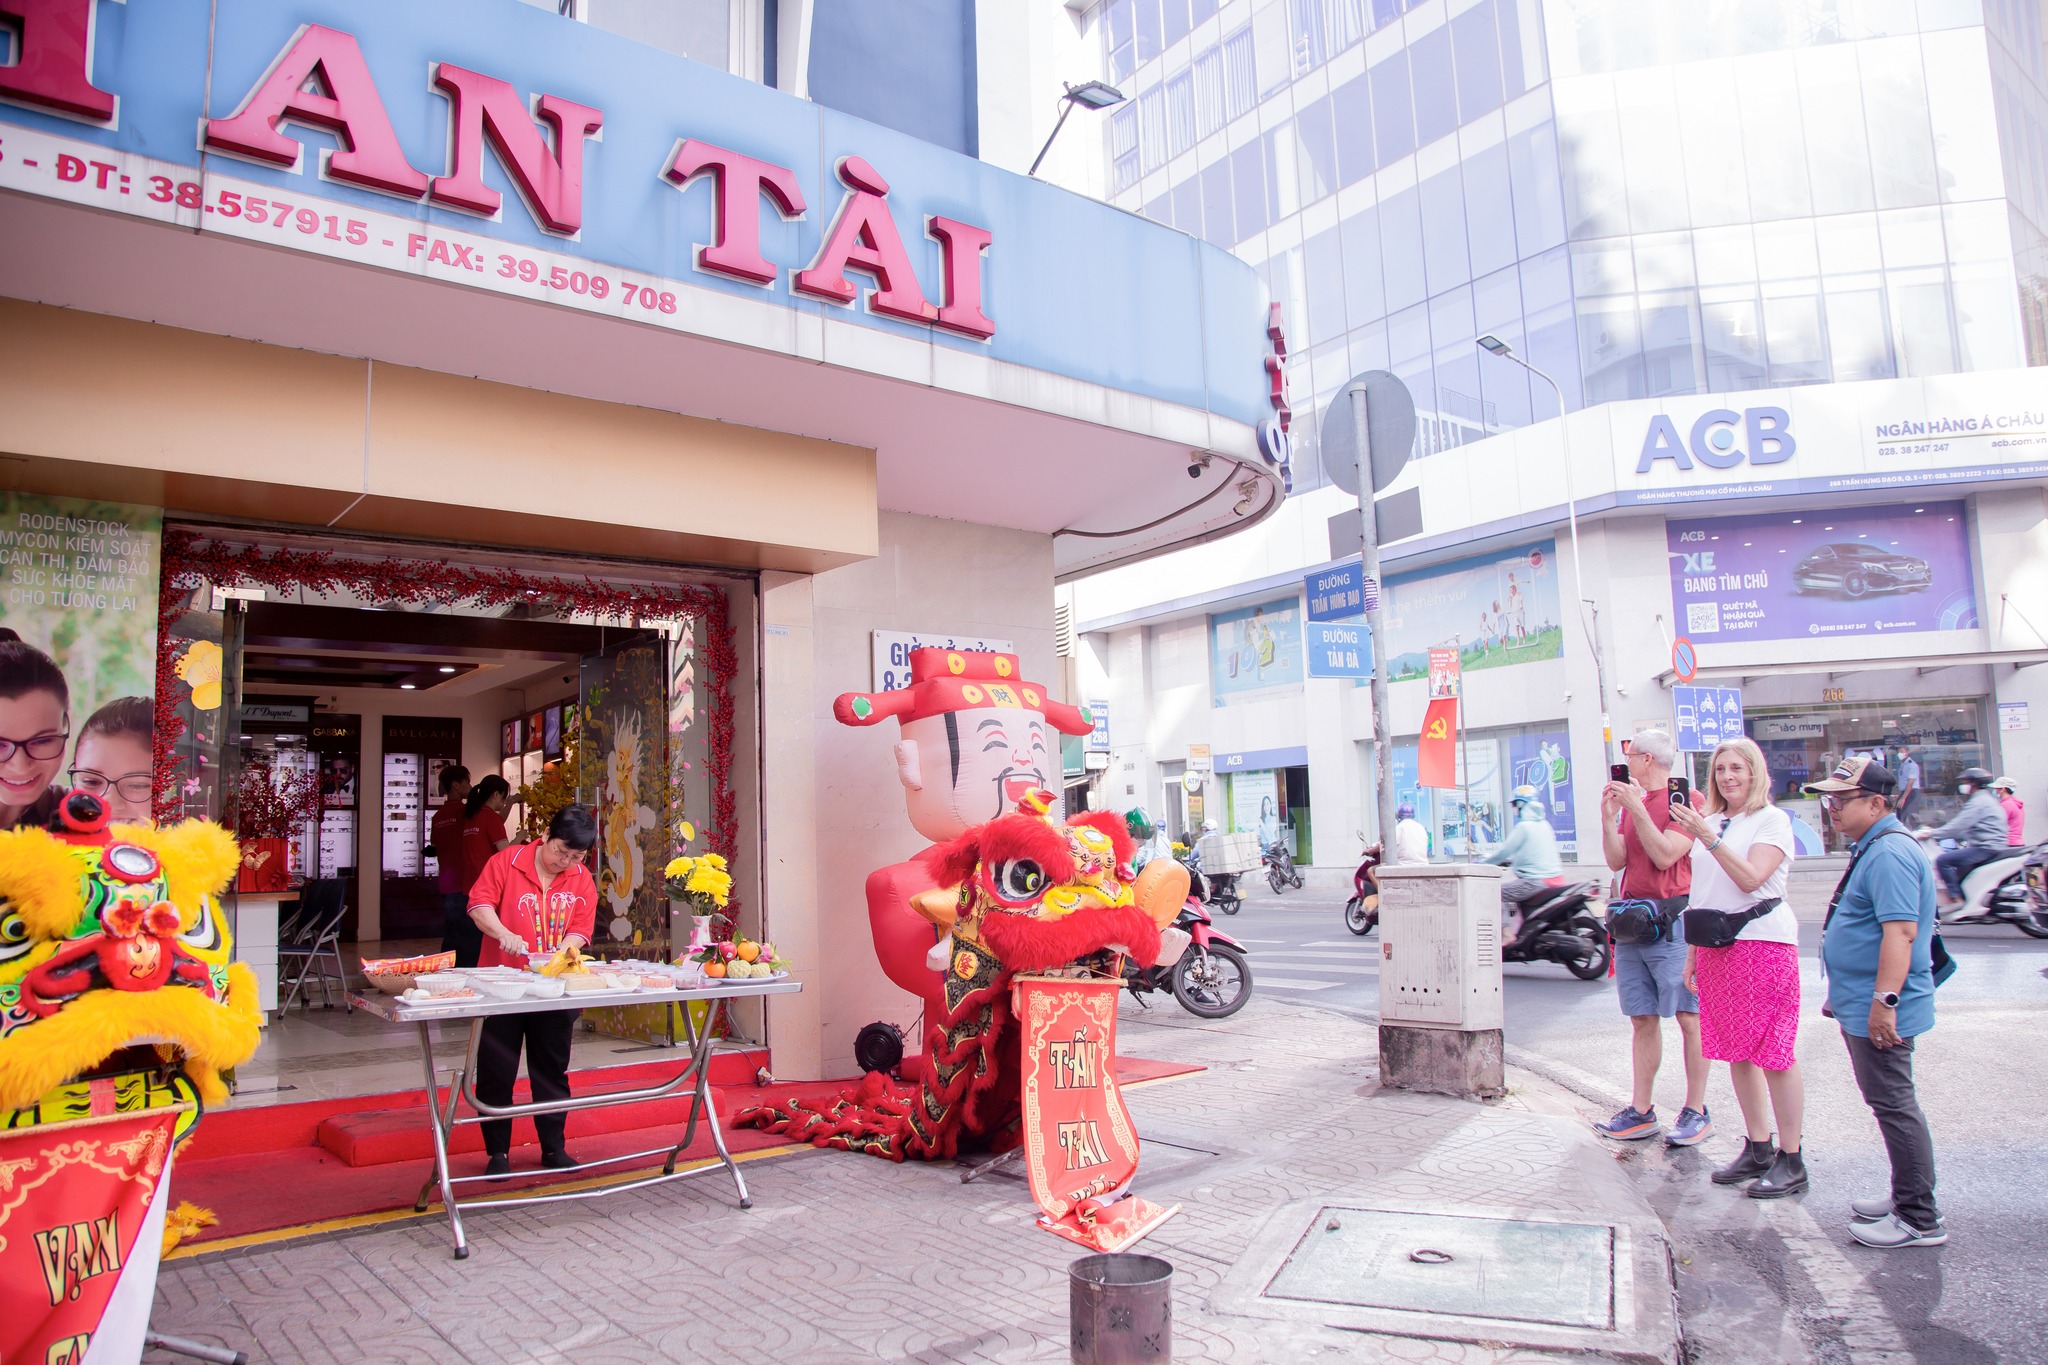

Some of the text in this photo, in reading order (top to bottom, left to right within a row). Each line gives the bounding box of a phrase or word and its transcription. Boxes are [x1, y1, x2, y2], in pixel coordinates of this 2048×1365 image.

[206, 23, 603, 234] AN
[666, 137, 995, 340] TÀI
[56, 153, 131, 195] ĐT:
[148, 175, 368, 246] 38.557915
[408, 233, 485, 272] FAX:
[496, 254, 610, 300] 39.509
[621, 281, 677, 315] 708
[1876, 411, 2045, 437] NGÂN HÀNG Á CHÂU
[1635, 405, 1796, 474] ACB
[1879, 448, 1898, 456] 028.
[1914, 445, 1930, 453] 247
[1933, 444, 1949, 452] 247
[1991, 437, 2047, 448] acb.com.vn
[19, 513, 130, 537] RODENSTOCK
[0, 531, 151, 557] MYCON KIỂM SOÁT
[1680, 531, 1706, 542] ACB
[40, 553, 69, 572] THỊ,
[75, 553, 112, 573] ĐẢM
[118, 556, 149, 576] BẢO
[1682, 551, 1717, 575] XE
[12, 566, 136, 592] SỨC KHỎE MẮT
[1318, 573, 1351, 591] ĐƯỜNG
[1684, 569, 1768, 593] ĐANG TÌM CHỦ
[9, 589, 136, 611] CHO TƯƠNG LAI
[1447, 587, 1467, 602] vui
[1323, 628, 1358, 643] ĐƯỜNG
[1327, 646, 1359, 668] TẢN ĐÀ
[1823, 688, 1845, 701] 268
[260, 706, 297, 719] Dupont
[389, 728, 456, 740] BVLGARI
[1092, 731, 1108, 744] 268
[1124, 763, 1135, 771] 268
[1226, 755, 1243, 766] ACB
[1050, 1024, 1098, 1089] TẤN
[1058, 1110, 1112, 1171] TÀI
[33, 1207, 122, 1308] VẠN
